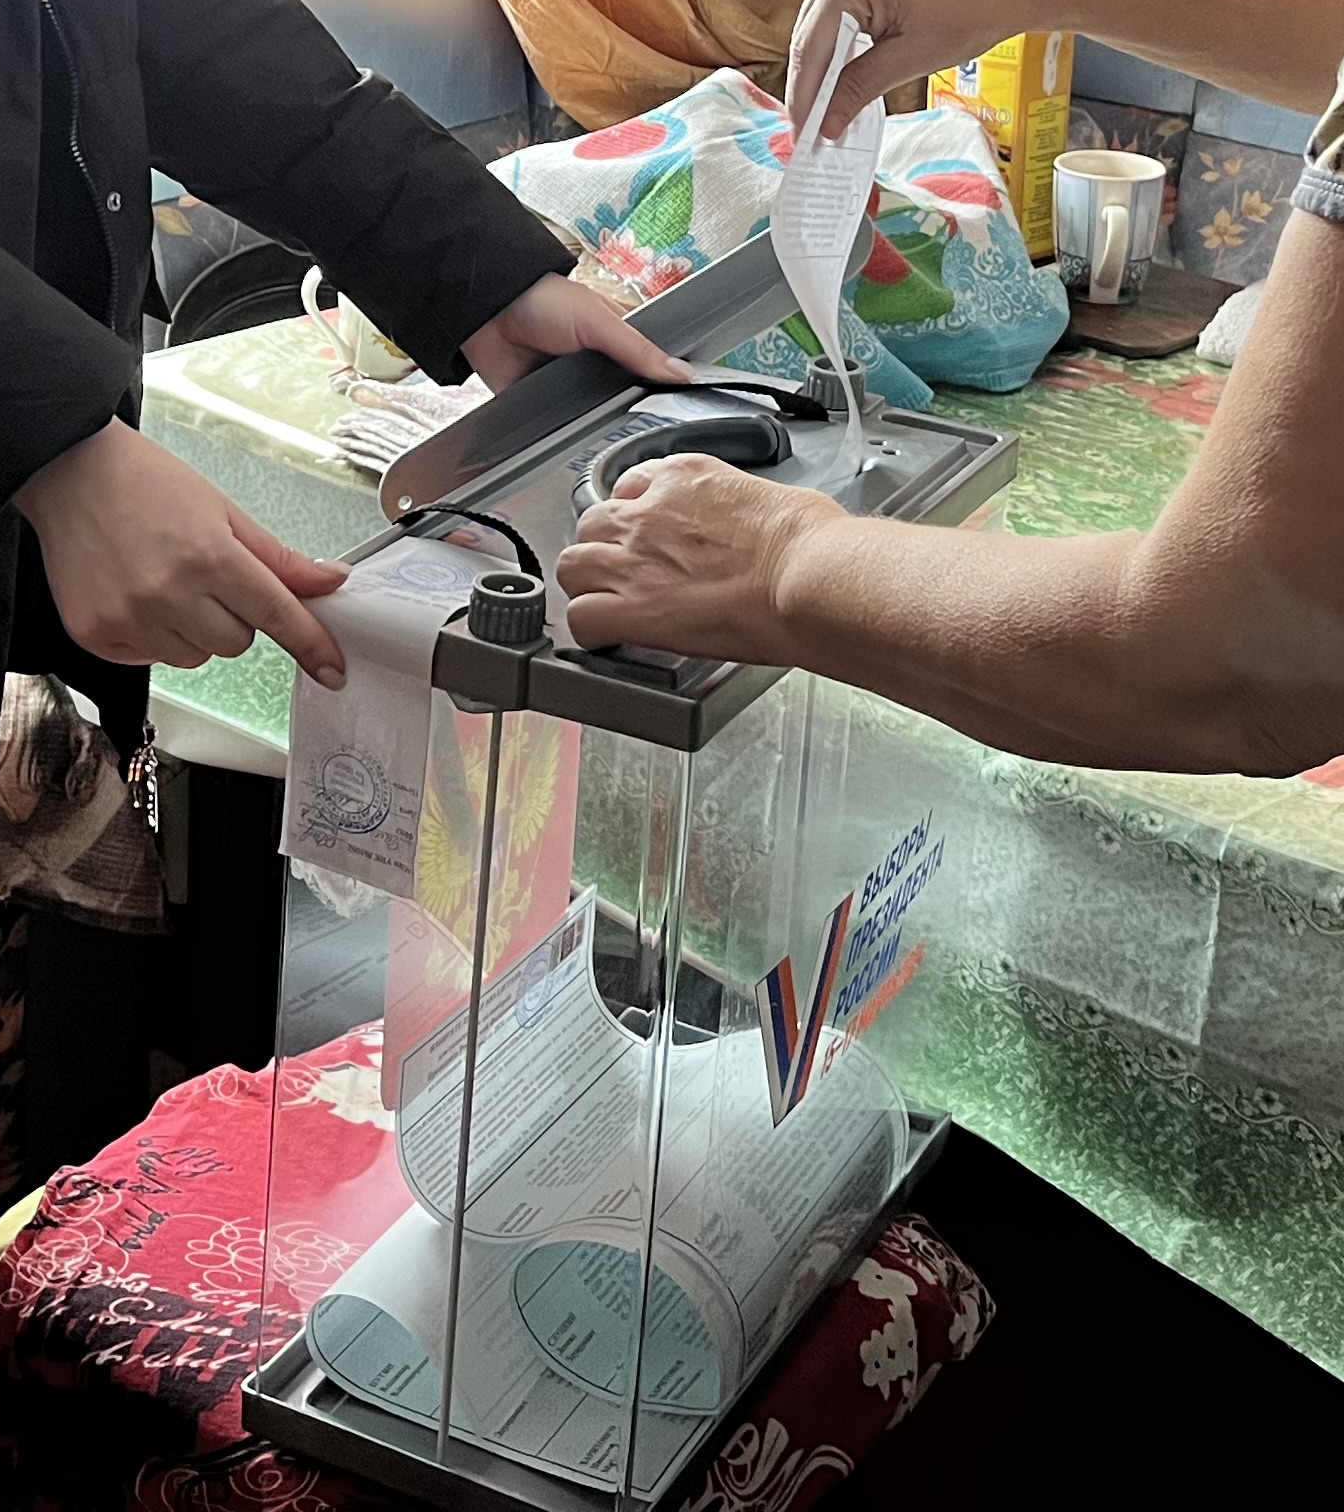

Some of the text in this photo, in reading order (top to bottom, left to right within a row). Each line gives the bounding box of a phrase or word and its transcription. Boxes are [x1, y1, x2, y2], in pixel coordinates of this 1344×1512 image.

[846, 834, 945, 973] ПРЕЗИДЕНТА
[859, 808, 933, 915] ВЫБОРЫ
[832, 925, 902, 1029] РОССИИ
